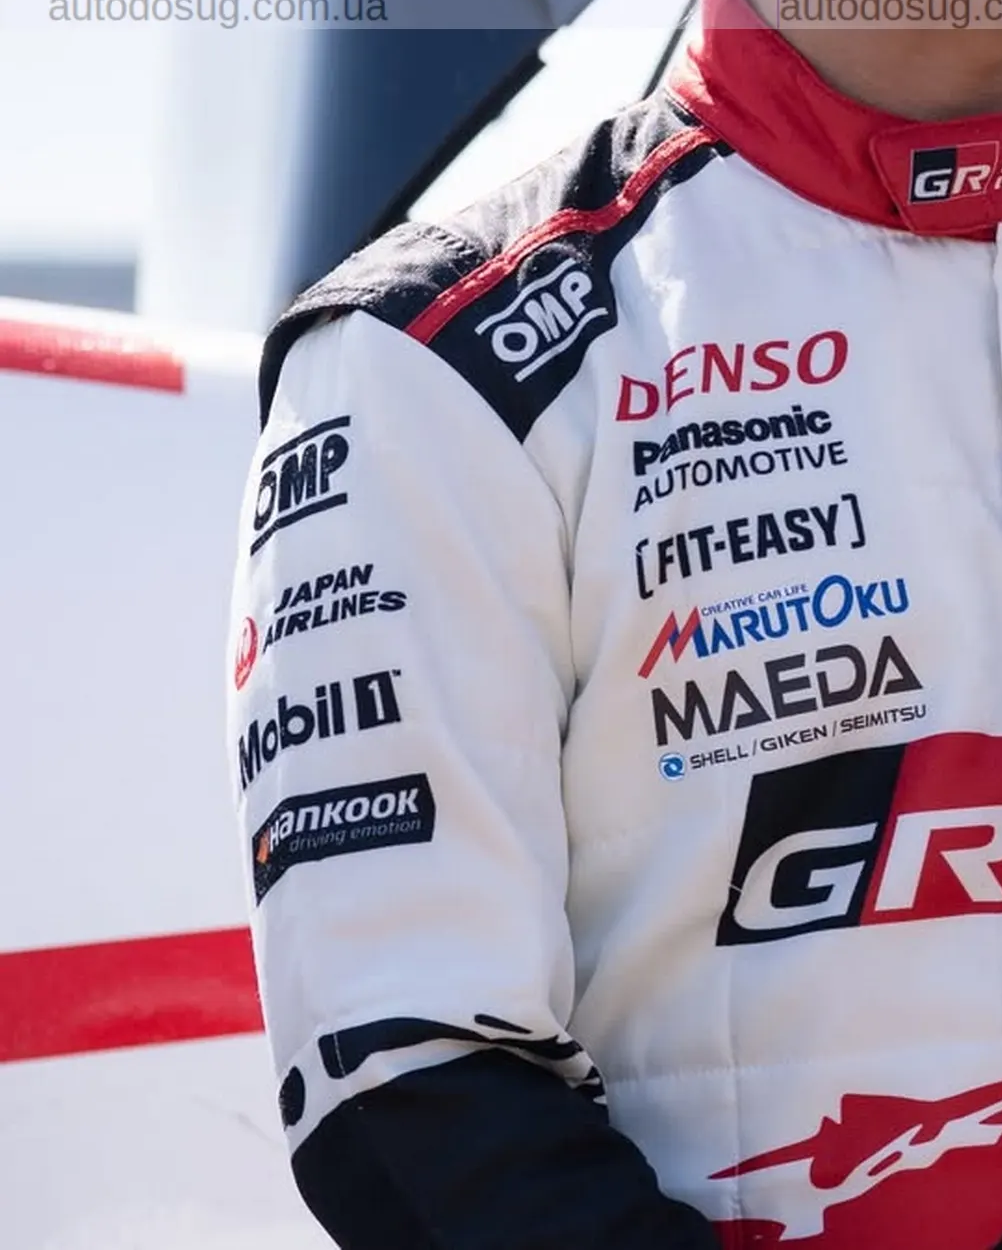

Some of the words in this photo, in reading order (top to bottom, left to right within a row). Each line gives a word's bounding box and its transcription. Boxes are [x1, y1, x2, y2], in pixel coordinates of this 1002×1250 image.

[914, 164, 991, 198] GR
[492, 269, 594, 363] OMP
[615, 330, 849, 422] DENSO
[633, 405, 832, 476] Panasonic
[253, 433, 350, 531] OMP
[633, 441, 848, 512] AUTOMOTIVE
[263, 590, 408, 654] AIRLINES
[274, 563, 373, 614] JAPAN
[701, 597, 754, 617] CREATIVE
[758, 589, 782, 602] CAR
[785, 583, 809, 596] LIFE
[651, 635, 923, 747] MAEDA
[239, 681, 346, 791] Mobil
[690, 746, 748, 769] SHELL
[760, 724, 827, 752] GIKEN
[840, 703, 927, 733] SEIMITSU
[289, 827, 346, 852] driving
[350, 818, 421, 840] emotion
